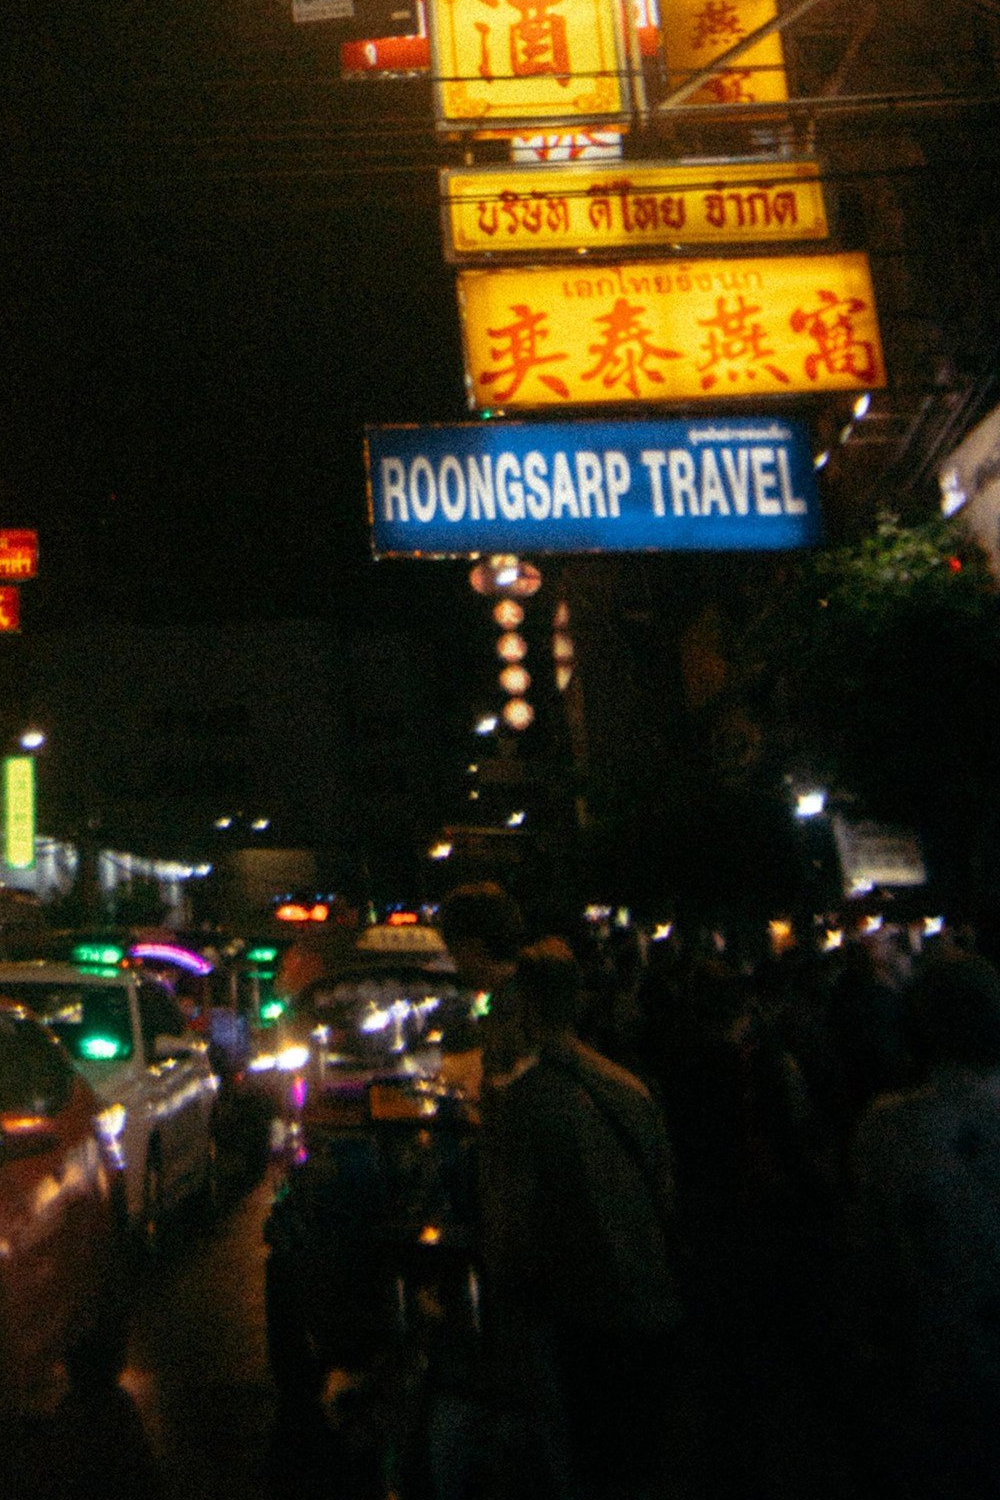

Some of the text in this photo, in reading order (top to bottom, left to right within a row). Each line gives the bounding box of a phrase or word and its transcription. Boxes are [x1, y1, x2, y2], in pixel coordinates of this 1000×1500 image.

[478, 188, 570, 236] บริษัท
[380, 446, 808, 523] ROONGSARP TRAVEL
